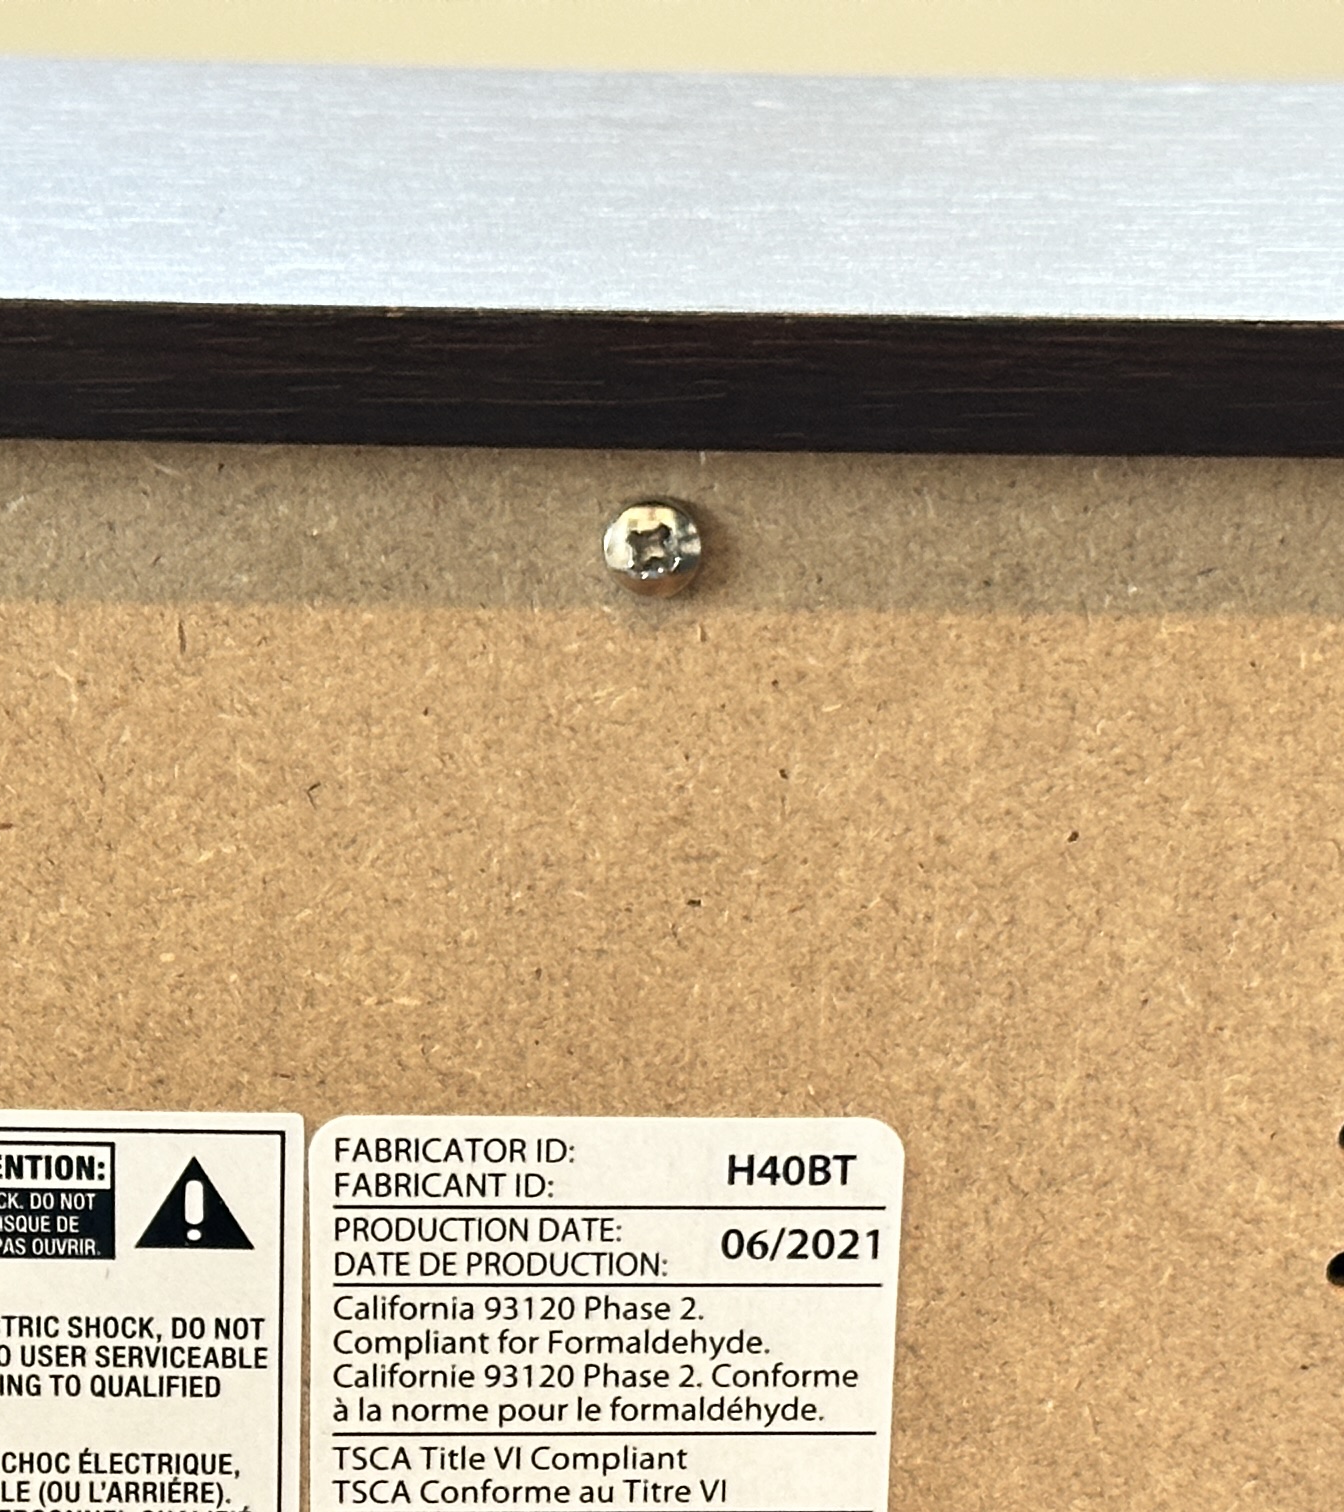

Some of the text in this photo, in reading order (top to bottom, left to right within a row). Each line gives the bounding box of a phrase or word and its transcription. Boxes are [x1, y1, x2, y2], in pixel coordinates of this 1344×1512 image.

[335, 1137, 574, 1163] FABRICATOR ID:
[727, 1154, 857, 1186] H40BT
[335, 1172, 554, 1198] FABRICANT ID:
[30, 1192, 54, 1210] DO
[60, 1192, 96, 1210] NOT
[57, 1215, 79, 1233] DE
[335, 1217, 622, 1242] PRODUCTION DATE:
[32, 1238, 101, 1256] OUVRIR.
[721, 1227, 879, 1261] 06/2021
[335, 1251, 667, 1277] DATE DE PRODUCTION:
[333, 1294, 704, 1321] California 93120 Phase 2.
[68, 1316, 162, 1343] SHOCK,
[172, 1317, 205, 1340] DO
[215, 1317, 265, 1340] NOT
[333, 1328, 770, 1361] Compliant for Formaldehyde.
[333, 1362, 858, 1388] Californie 93120 Phase 2. Conforme
[359, 1396, 381, 1422] la
[392, 1404, 489, 1422] norme
[499, 1403, 569, 1428] pour
[577, 1396, 601, 1422] le
[610, 1396, 824, 1428] formaldéhyde.
[1, 1451, 70, 1474] CHOC
[79, 1447, 240, 1479] ÉLECTRIQUE,
[332, 1444, 688, 1477] TSCA Title VI Compliant
[332, 1478, 726, 1504] TSCA Conforme au Titre VI
